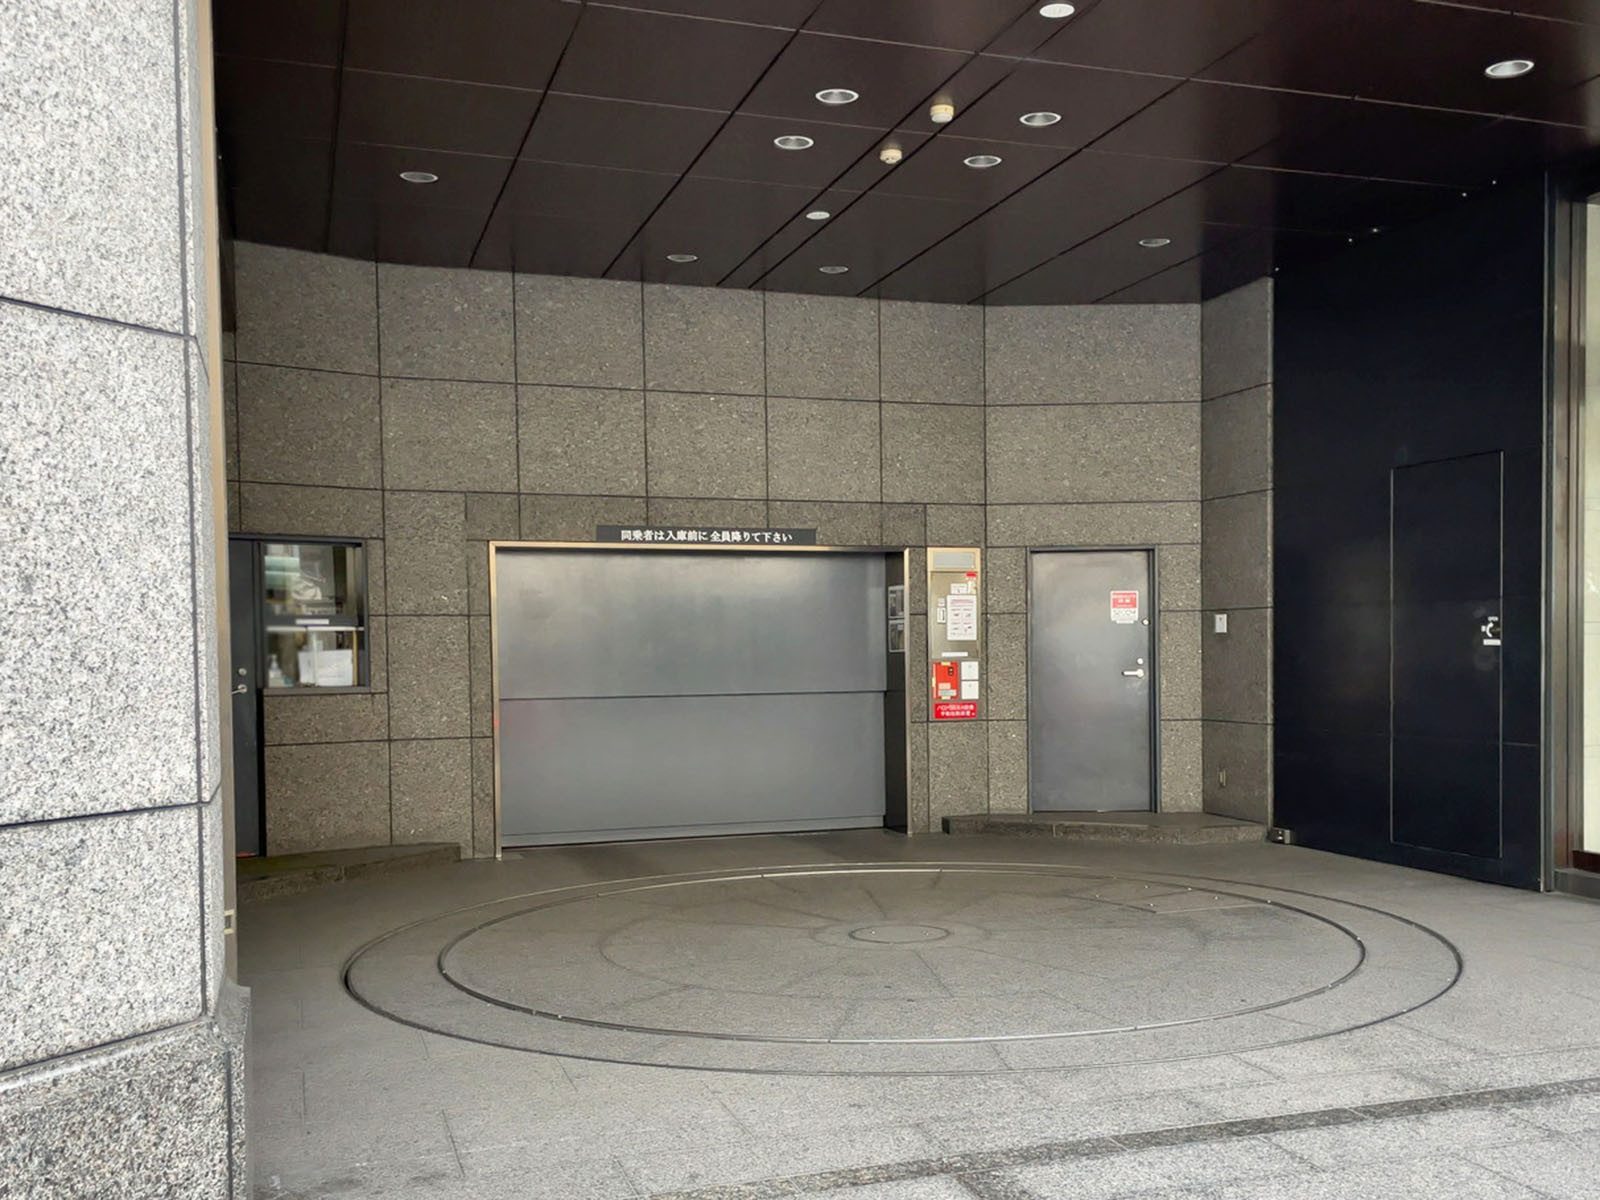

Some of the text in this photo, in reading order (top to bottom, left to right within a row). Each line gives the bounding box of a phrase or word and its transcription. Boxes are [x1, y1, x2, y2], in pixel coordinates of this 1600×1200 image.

[621, 529, 793, 544] 同乗者は入庫前に 全員降りて下さい
